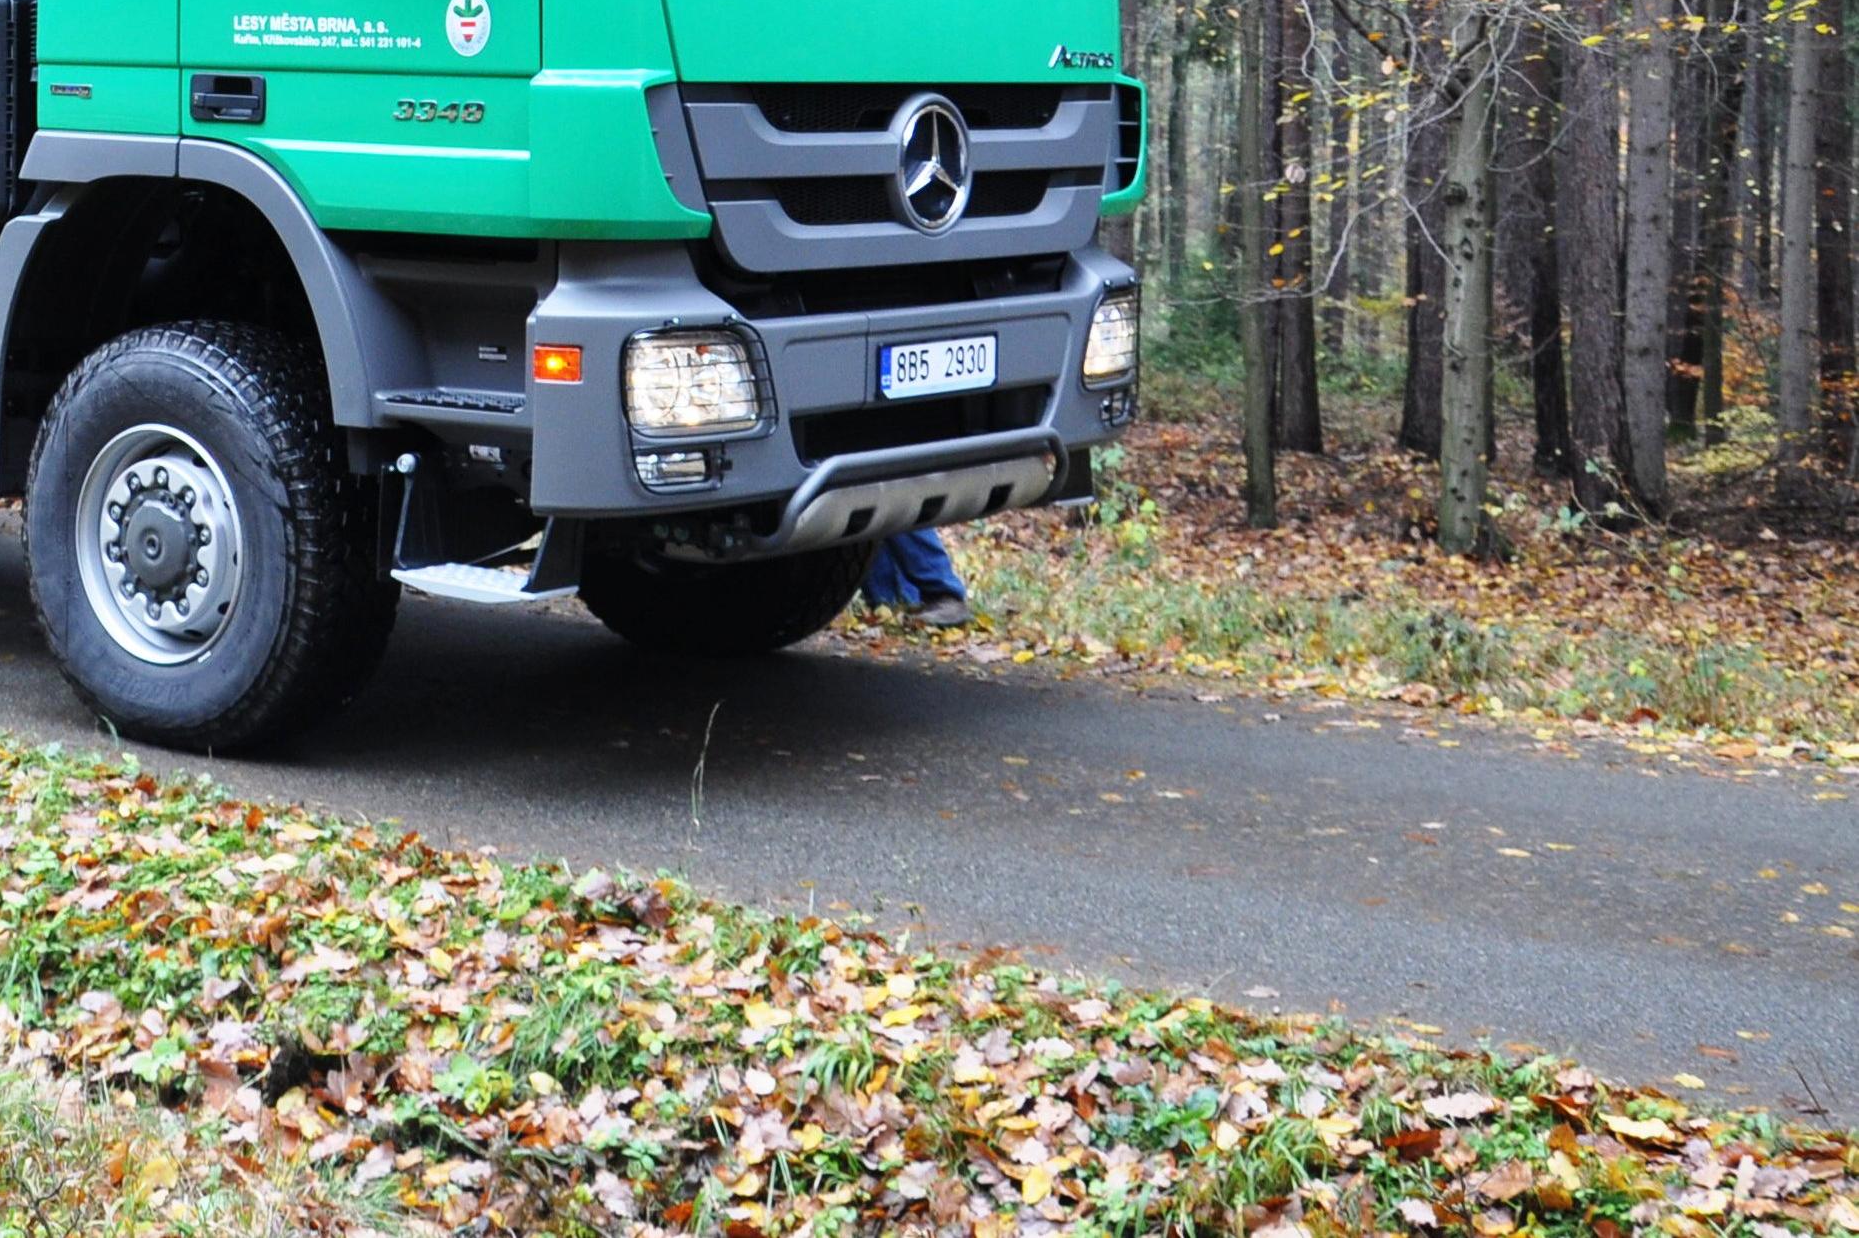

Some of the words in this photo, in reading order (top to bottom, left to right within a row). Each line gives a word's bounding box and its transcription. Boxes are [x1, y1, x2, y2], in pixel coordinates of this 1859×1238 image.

[233, 15, 267, 31] LESY
[269, 12, 315, 32] MĚSTA
[317, 16, 361, 35] BRNA,
[359, 37, 376, 48] 541
[377, 37, 393, 49] 231
[392, 98, 485, 123] 3348
[897, 349, 929, 383] 8B5
[945, 343, 987, 378] 2930
